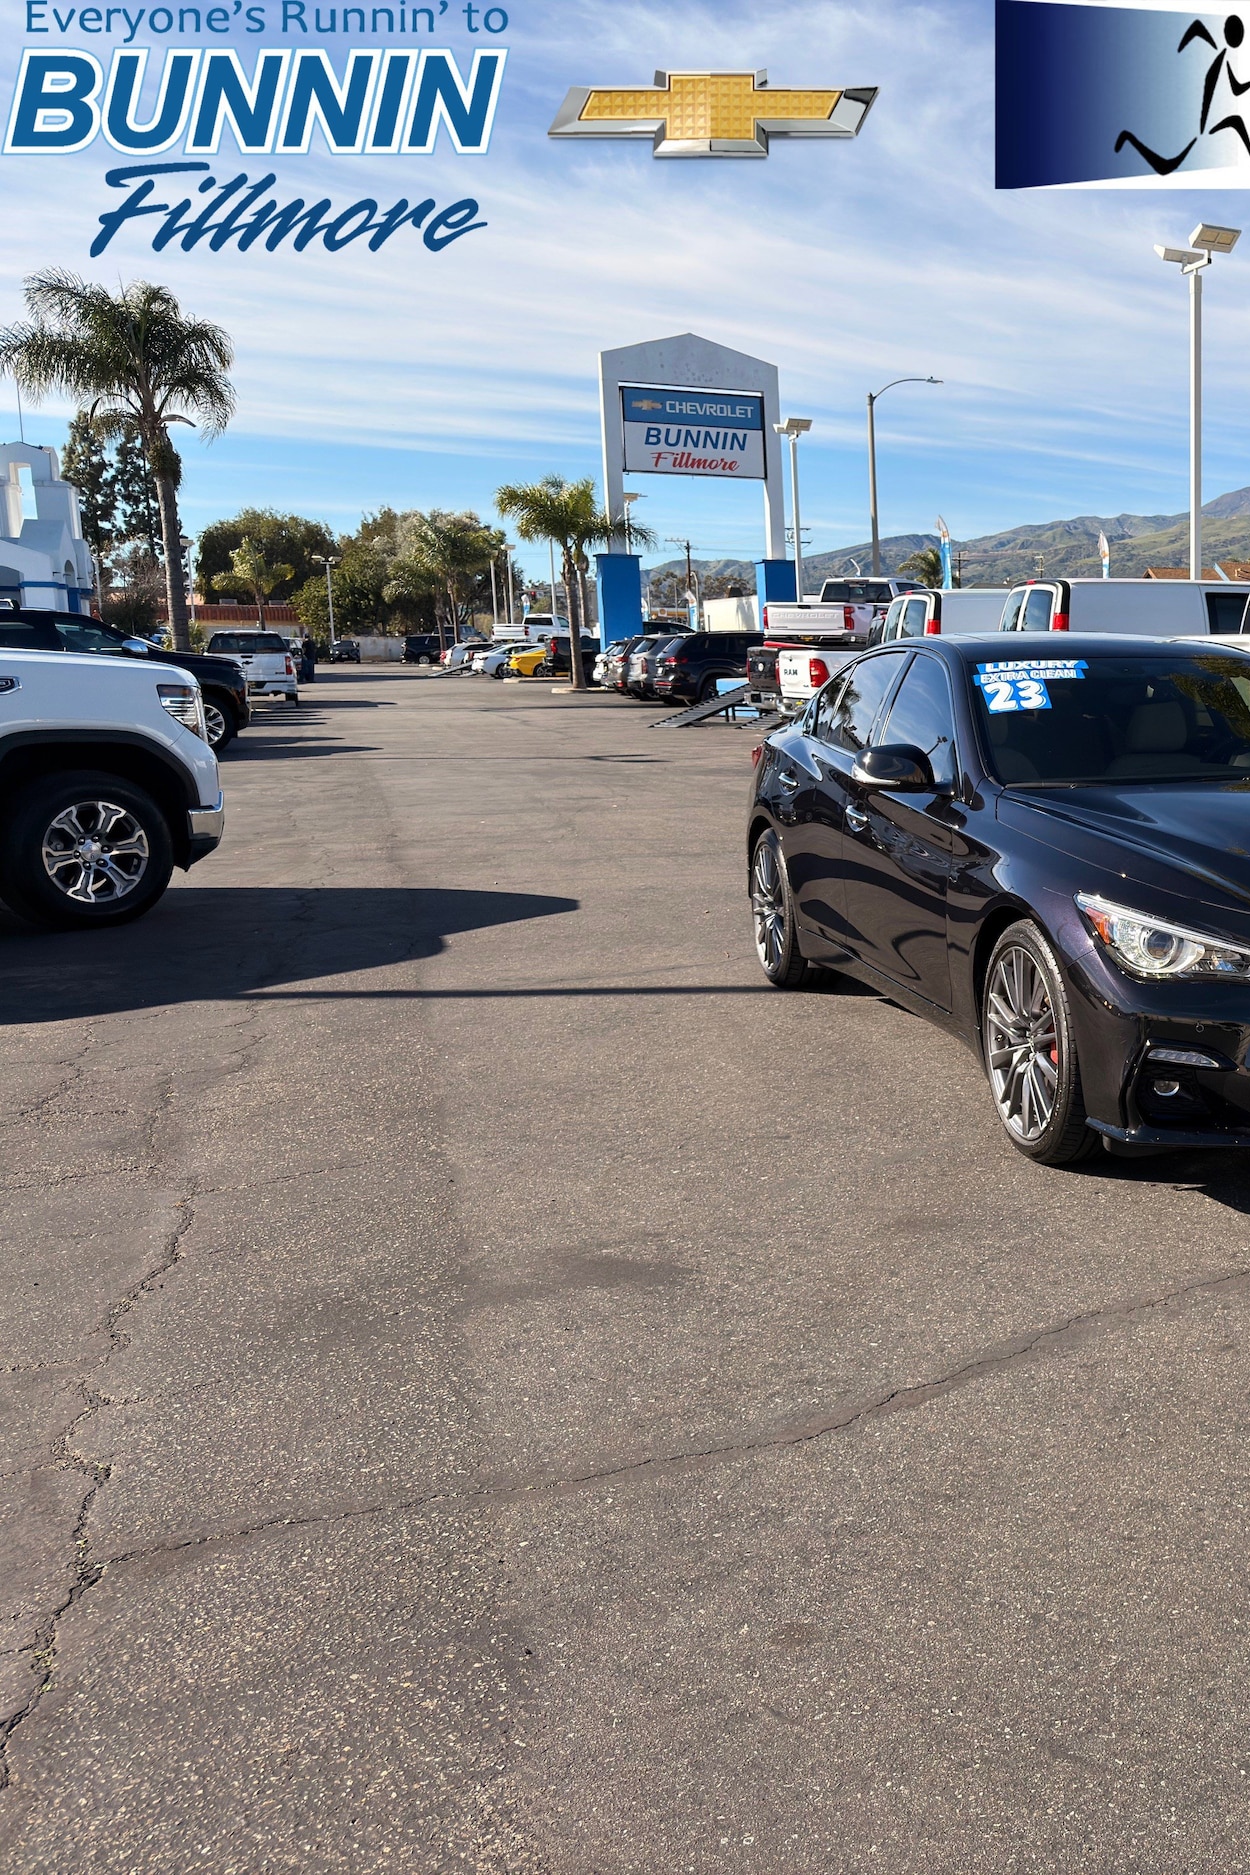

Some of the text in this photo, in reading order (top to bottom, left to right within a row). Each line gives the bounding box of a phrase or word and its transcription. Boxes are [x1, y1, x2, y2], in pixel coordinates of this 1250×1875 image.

[665, 400, 754, 419] CHEVROLET
[644, 427, 748, 451] BUNNIN
[650, 451, 740, 471] Fillmore
[783, 668, 798, 676] RAM
[980, 668, 1077, 683] EXTRA CLEAN
[985, 660, 1079, 673] LUXURY
[984, 679, 1047, 711] 23
